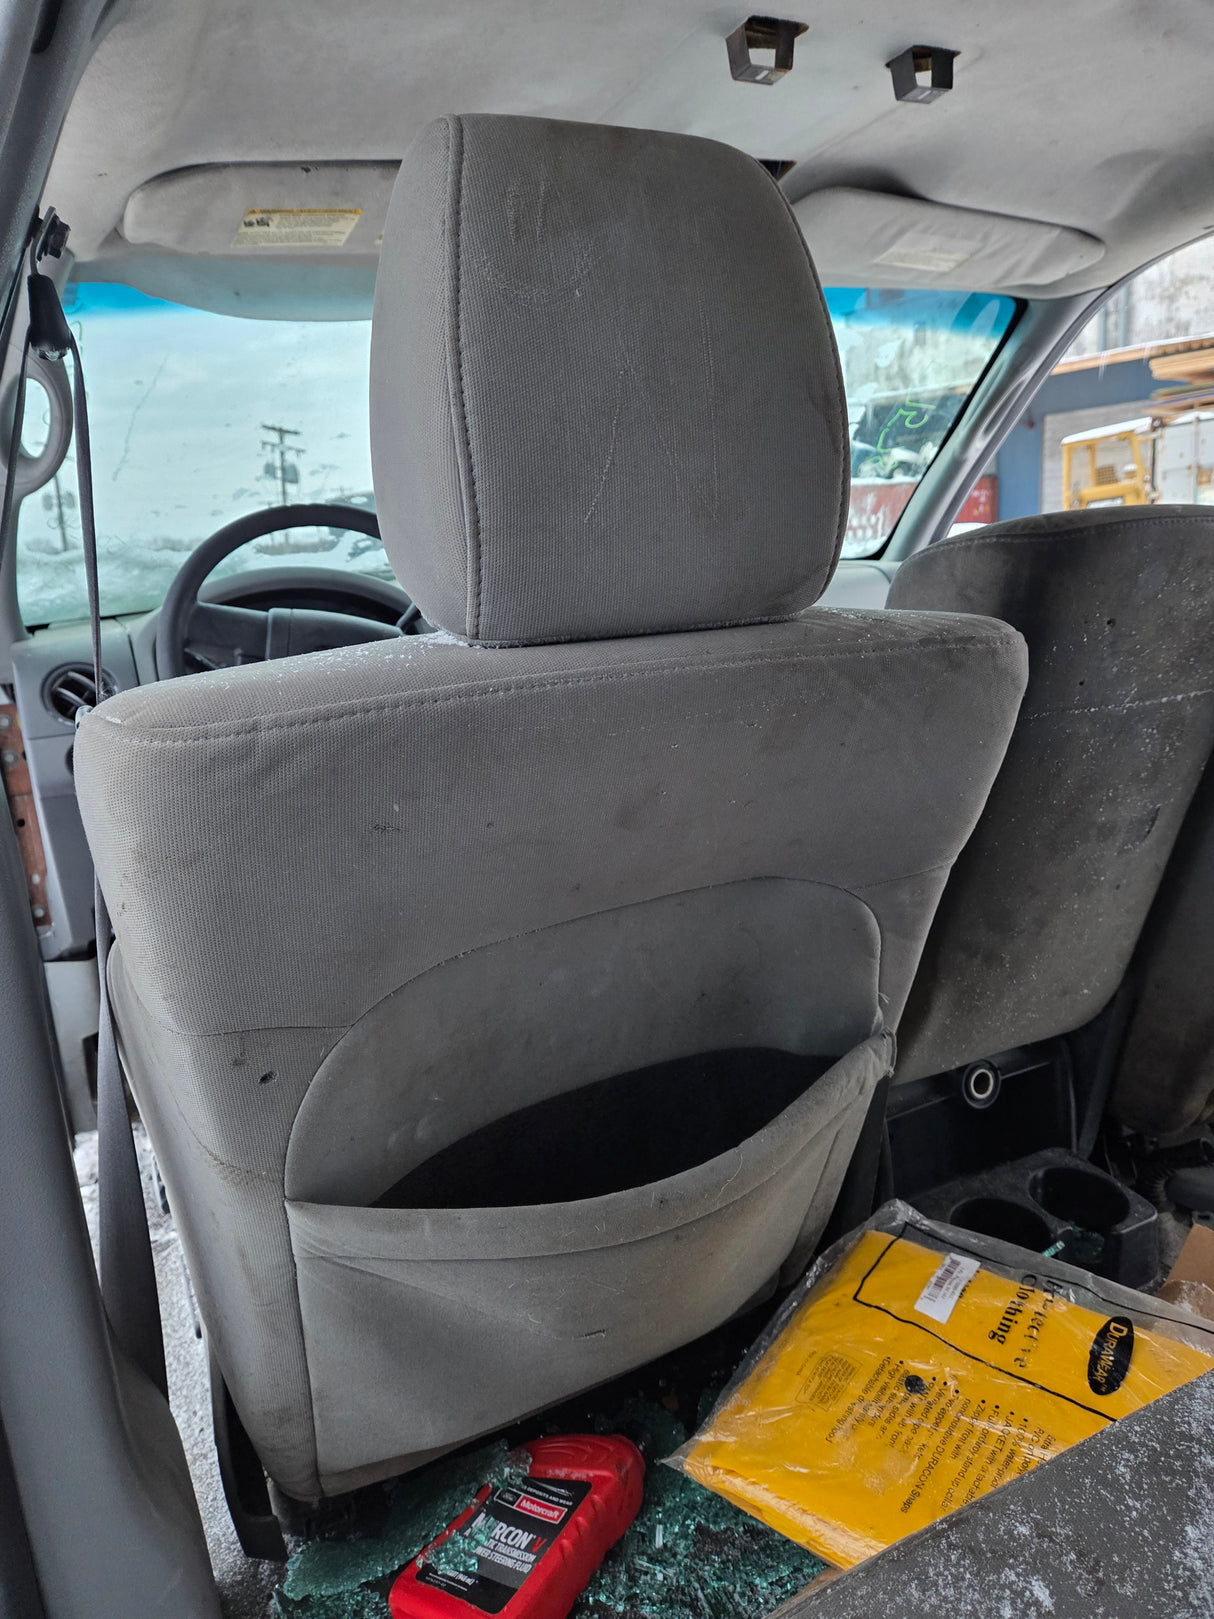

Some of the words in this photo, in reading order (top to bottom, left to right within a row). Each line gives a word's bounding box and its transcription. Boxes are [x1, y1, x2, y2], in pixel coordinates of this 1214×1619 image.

[988, 1274, 1037, 1345] Clothing
[1014, 1280, 1063, 1367] Protecte
[870, 1380, 891, 1405] visibilit
[893, 1369, 911, 1393] eastic
[836, 1394, 865, 1425] drstring
[867, 1391, 898, 1428] susnders
[970, 1403, 986, 1428] Zippr
[910, 1417, 924, 1434] cpe
[951, 1447, 963, 1460] with
[915, 1444, 945, 1490] DURACON
[957, 1456, 974, 1479] stand
[965, 1463, 989, 1505] dtachable
[520, 1499, 559, 1518] Motorcraft
[900, 1489, 920, 1513] Snaps
[472, 1513, 533, 1550] MRCON
[532, 1537, 547, 1553] V
[488, 1551, 517, 1569] STEERING
[513, 1559, 533, 1574] FLUID
[493, 1541, 536, 1562] TRANSMISSION
